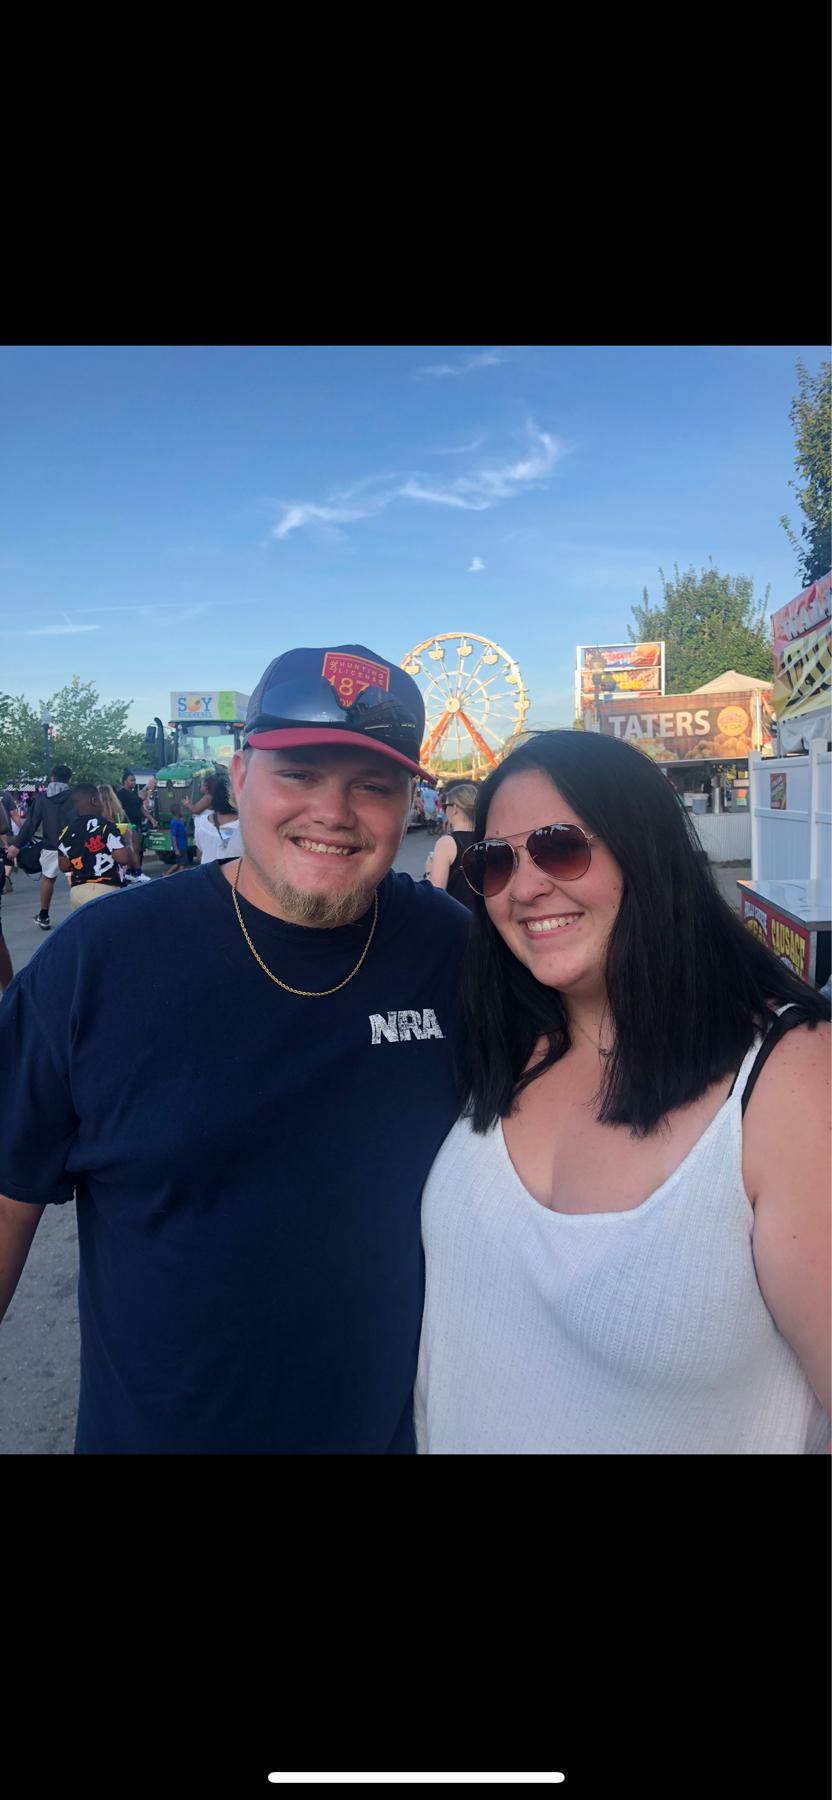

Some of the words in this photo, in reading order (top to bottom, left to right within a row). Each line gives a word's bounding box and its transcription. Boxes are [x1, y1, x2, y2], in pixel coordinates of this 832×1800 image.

[177, 696, 213, 713] SOY
[608, 710, 711, 738] TATERS
[368, 1008, 446, 1045] NRA
